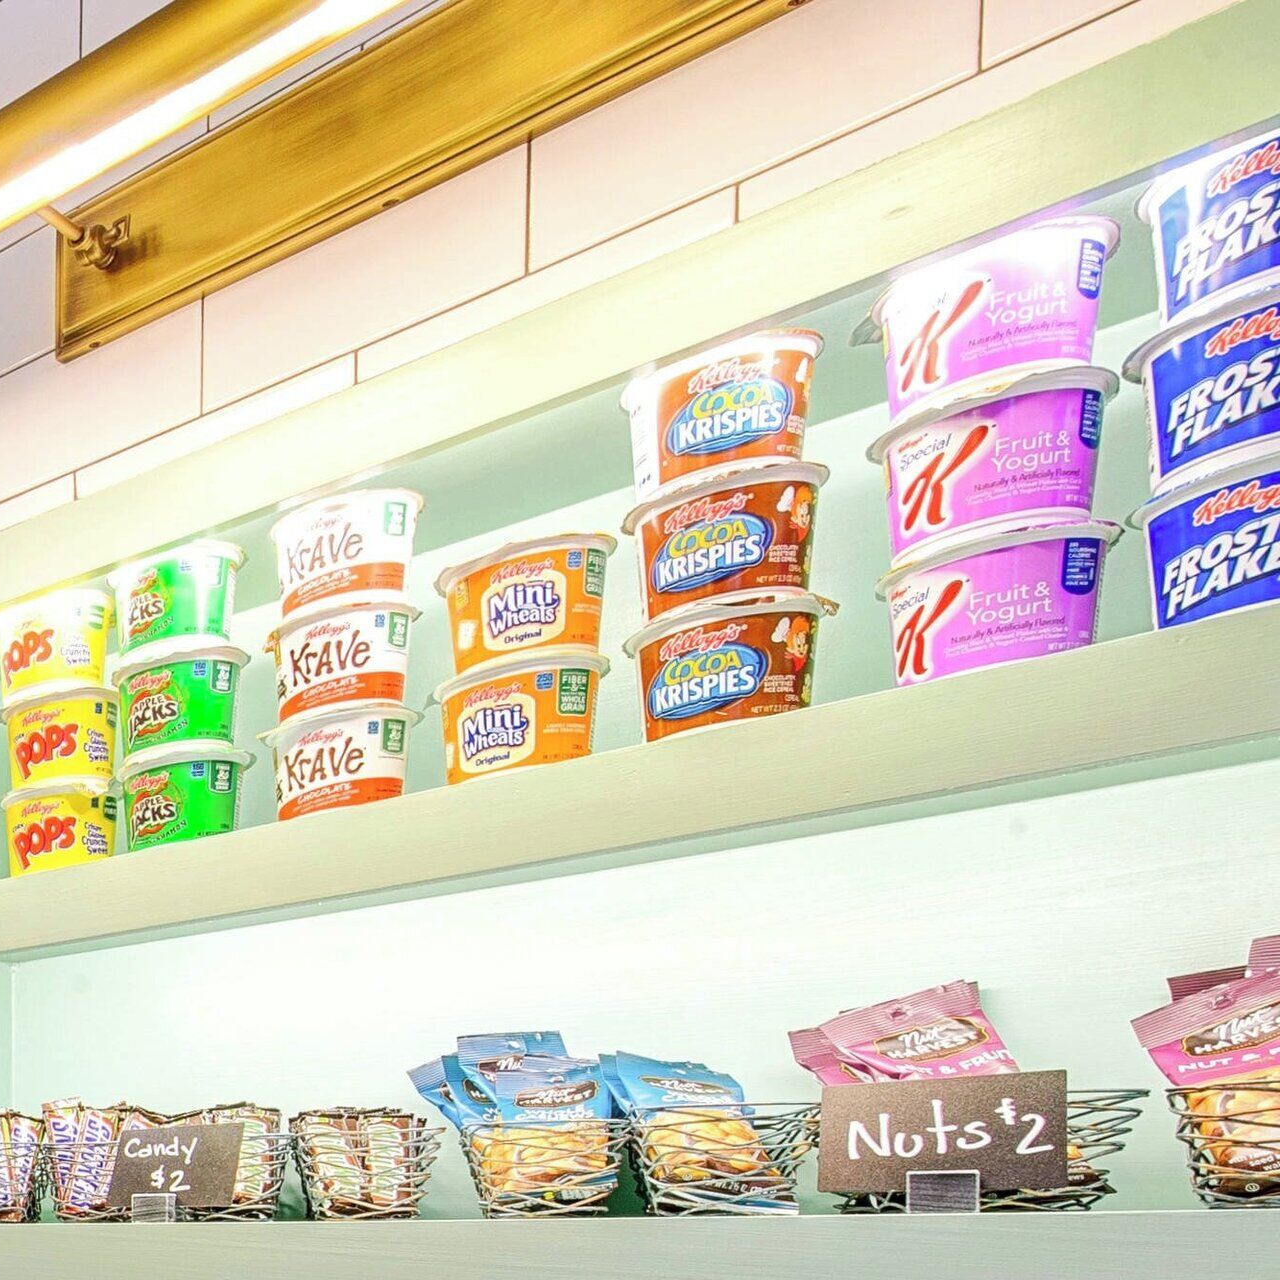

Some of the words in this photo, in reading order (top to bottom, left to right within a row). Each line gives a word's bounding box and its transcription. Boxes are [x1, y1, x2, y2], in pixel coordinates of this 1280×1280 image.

[1176, 209, 1280, 301] FLAK
[991, 285, 1049, 309] Fruit
[1054, 283, 1068, 296] &
[986, 300, 1068, 326] Yogurt
[692, 382, 772, 416] COCOA
[679, 402, 784, 448] KRISPIES
[1171, 376, 1280, 457] FLAK
[901, 433, 952, 472] Special
[994, 432, 1053, 454] Fruit
[1056, 431, 1070, 446] &
[992, 448, 1071, 473] Yogurt
[902, 425, 989, 531] K
[974, 477, 1010, 493] Naturally
[664, 494, 748, 534] Kellogg's
[669, 519, 748, 558] COCOA
[658, 535, 761, 589] KRISPIES
[1163, 516, 1280, 595] FROST
[491, 559, 554, 584] Kellogg's
[489, 581, 559, 619] Mini
[970, 587, 1029, 609] Fruit
[1036, 582, 1050, 597] &
[489, 606, 555, 637] Wheats
[966, 598, 1052, 625] Yogurt
[305, 621, 351, 641] Kellogg's
[503, 629, 542, 645] Original
[660, 624, 739, 661] Kellogg's
[897, 580, 963, 678] K
[951, 626, 985, 644] Naturally
[994, 619, 1033, 635] Artificially
[3, 628, 54, 688] POPS
[665, 650, 742, 687] COCOA
[128, 671, 170, 694] Kellogg's
[302, 675, 359, 699] CHOCOLATE
[561, 675, 587, 685] FIBER
[655, 665, 756, 711] KRISPIES
[132, 697, 164, 715] APPLE
[463, 683, 522, 709] Kellogg's
[560, 695, 586, 705] WHOLE
[560, 703, 586, 712] GRAIN
[128, 701, 179, 744] JACKS
[462, 705, 528, 741] Mini
[15, 723, 80, 780] POPS
[297, 730, 345, 749] Kellogg's
[464, 730, 524, 760] Wheats
[475, 752, 510, 767] Original
[130, 772, 169, 795] Kellogg's
[296, 782, 352, 805] CHOCOLATE
[134, 796, 163, 814] APPLE
[130, 802, 177, 845] JACKS
[13, 816, 77, 870] POPS
[898, 1022, 947, 1048] Nut
[1213, 1007, 1272, 1040] Nut
[886, 1031, 978, 1059] HARVEST
[1178, 1056, 1234, 1073] NUT
[847, 1098, 992, 1161] Nuts
[995, 1096, 1056, 1157] $2
[123, 1136, 200, 1170] Candy
[150, 1168, 192, 1192] $2
